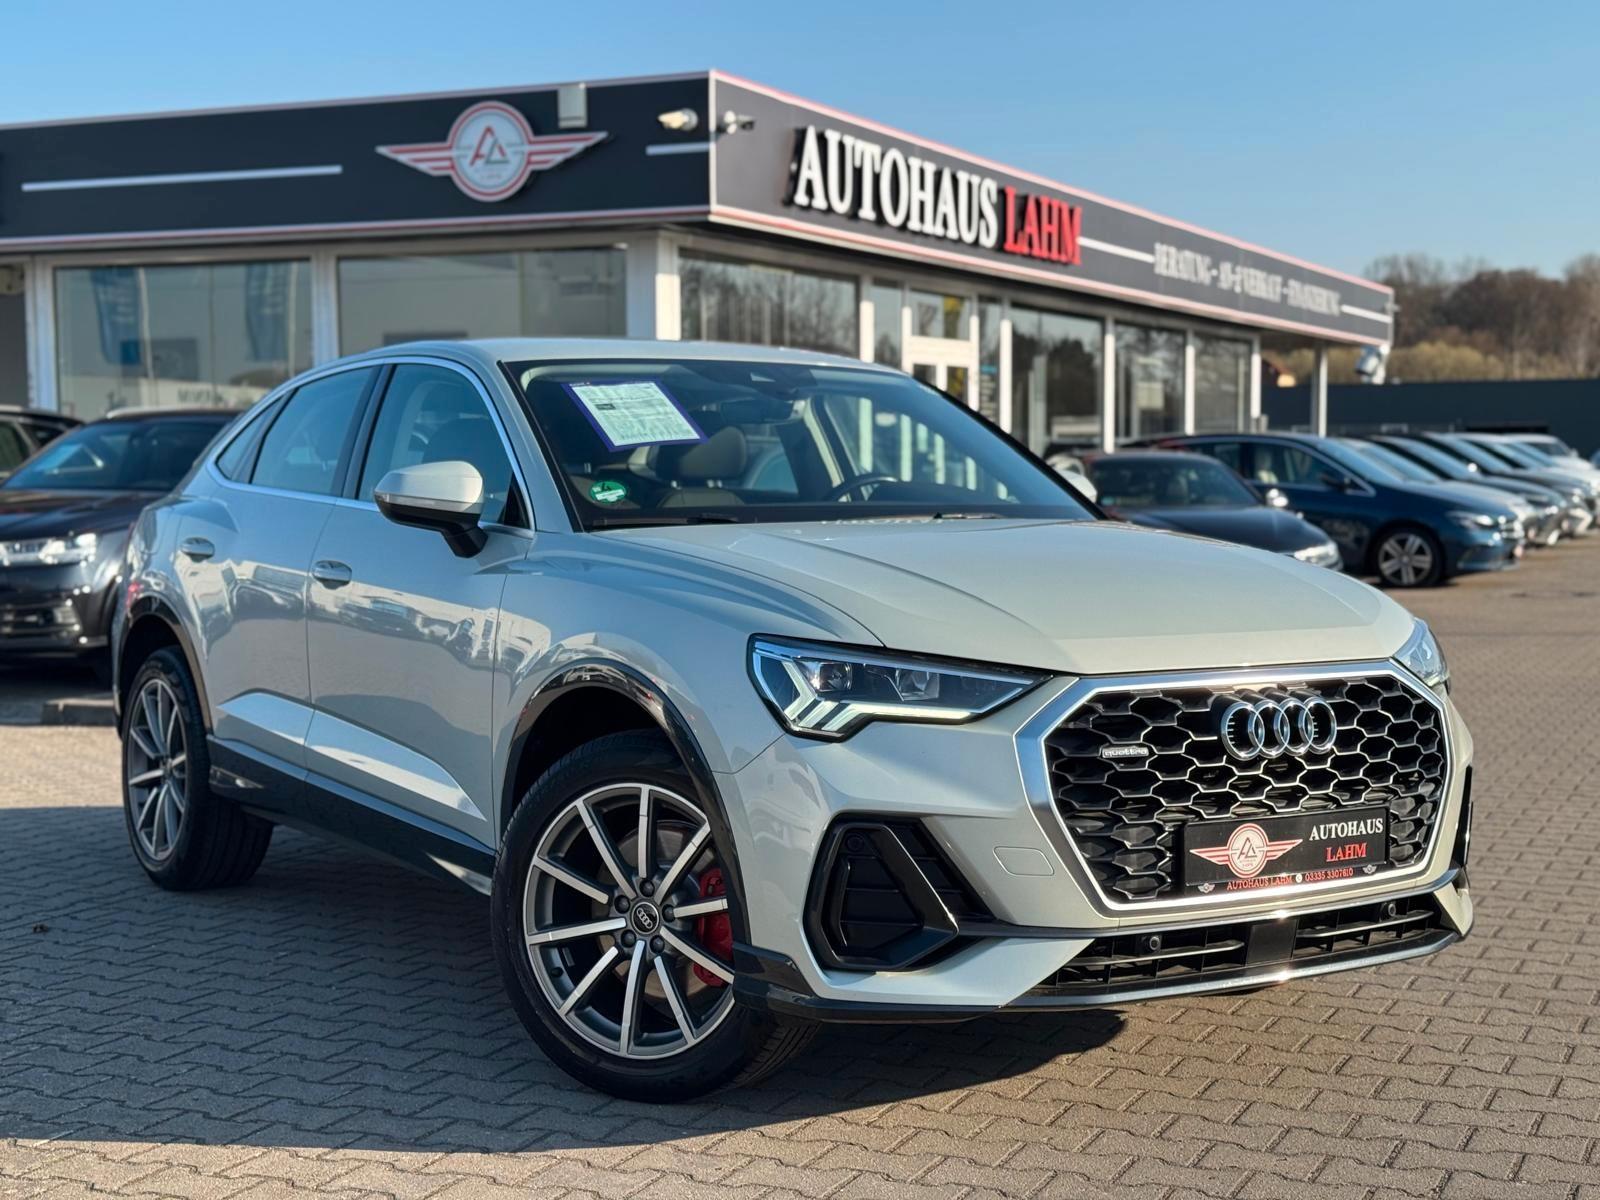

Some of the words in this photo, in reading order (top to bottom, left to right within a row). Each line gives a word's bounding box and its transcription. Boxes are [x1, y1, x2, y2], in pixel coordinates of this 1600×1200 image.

[794, 125, 998, 248] AUTOHAUS
[1004, 185, 1082, 265] LAHM
[1103, 747, 1148, 758] quattro
[1309, 818, 1384, 841] AUTOHAUS
[1326, 842, 1367, 862] LAHM
[1226, 877, 1269, 891] AUTOHAUS
[1270, 875, 1293, 887] LAHM
[1305, 871, 1326, 881] 03335
